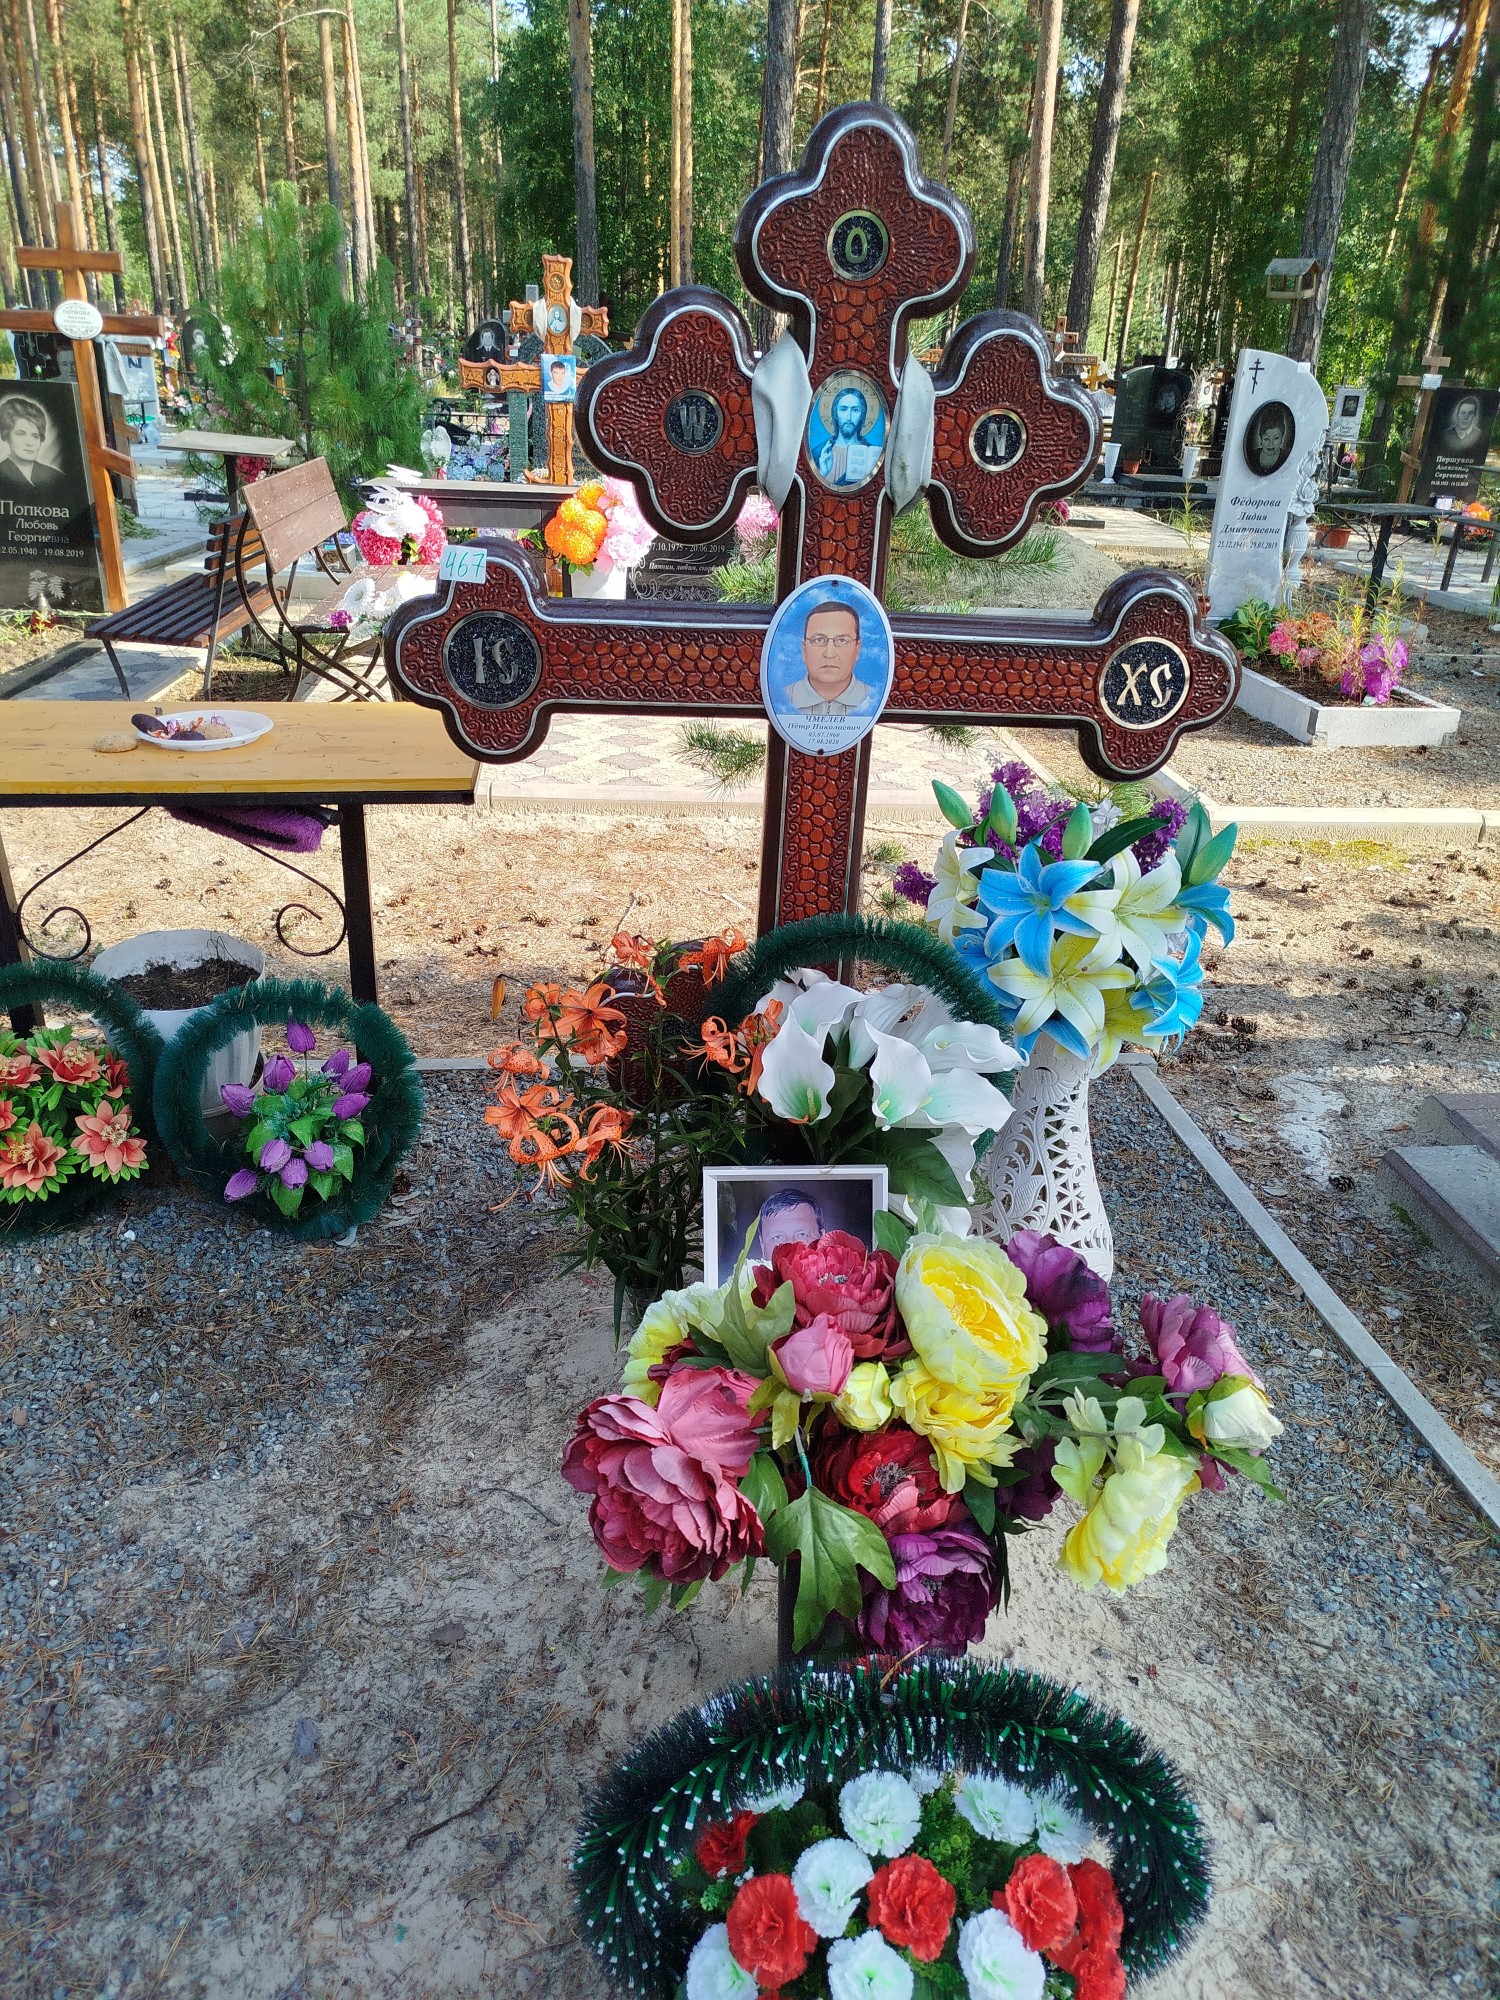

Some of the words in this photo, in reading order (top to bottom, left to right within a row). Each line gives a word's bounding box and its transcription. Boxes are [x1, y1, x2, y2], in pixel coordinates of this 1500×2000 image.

[0, 499, 70, 518] Попкова
[1230, 496, 1281, 509] Фёдорова
[1237, 511, 1268, 521] Лидия
[15, 518, 59, 531] Любовь
[8, 530, 70, 544] Георгиевна
[0, 546, 38, 556] 2.05.1940
[44, 548, 84, 558] 19.08.2019
[689, 543, 726, 553] 20.06.2019
[445, 551, 486, 578] 467
[805, 715, 847, 723] ЧМЕЛЕВ
[787, 722, 811, 731] Пётр
[812, 723, 861, 732] Николаевич
